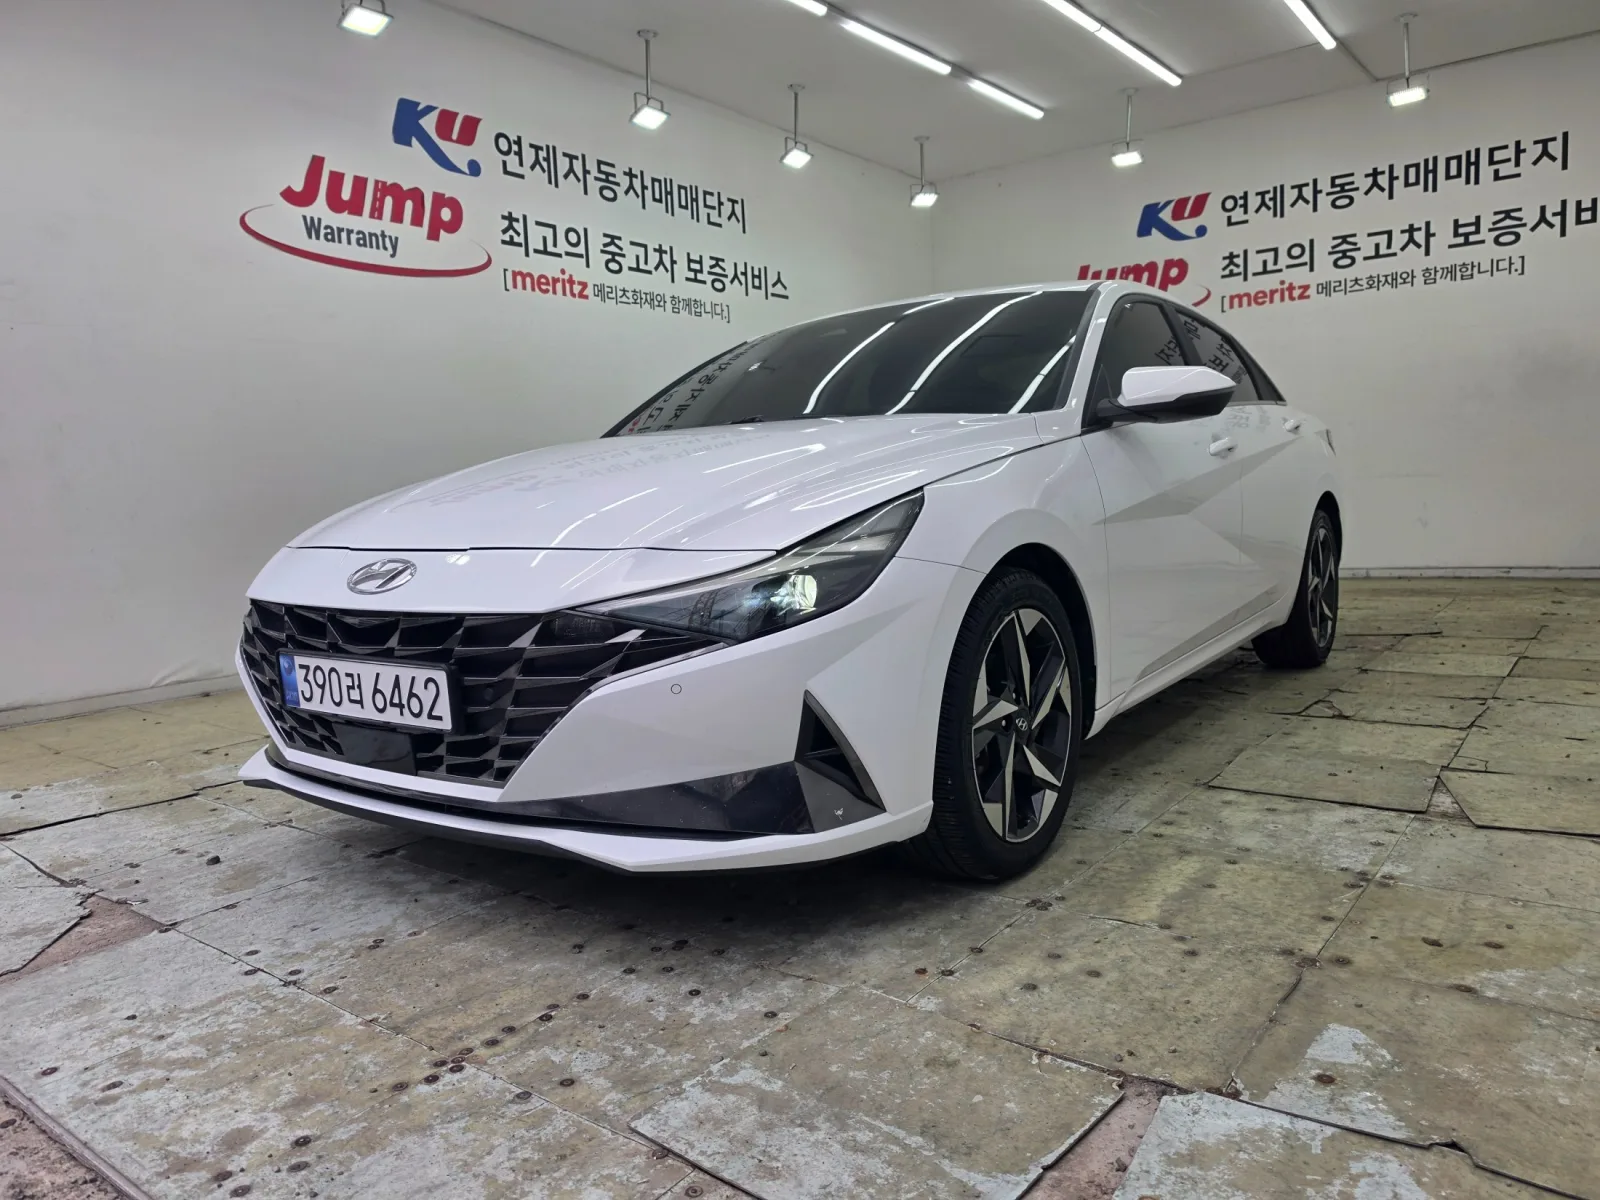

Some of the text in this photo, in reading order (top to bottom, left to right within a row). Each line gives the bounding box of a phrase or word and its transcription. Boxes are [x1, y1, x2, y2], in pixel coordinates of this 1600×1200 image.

[280, 155, 464, 242] Jump
[494, 132, 747, 234] 연제자동차매매단지
[1221, 131, 1569, 227] 연제자동차매매단지
[302, 215, 399, 258] Warranty
[501, 211, 789, 300] 최고의 중고차 보증서비스
[1221, 238, 1314, 282] 최고의
[1328, 220, 1436, 269] 중고차
[593, 283, 667, 312] 메리츠화재와
[1317, 269, 1416, 297] 메리츠화재와
[372, 672, 443, 721] 6462
